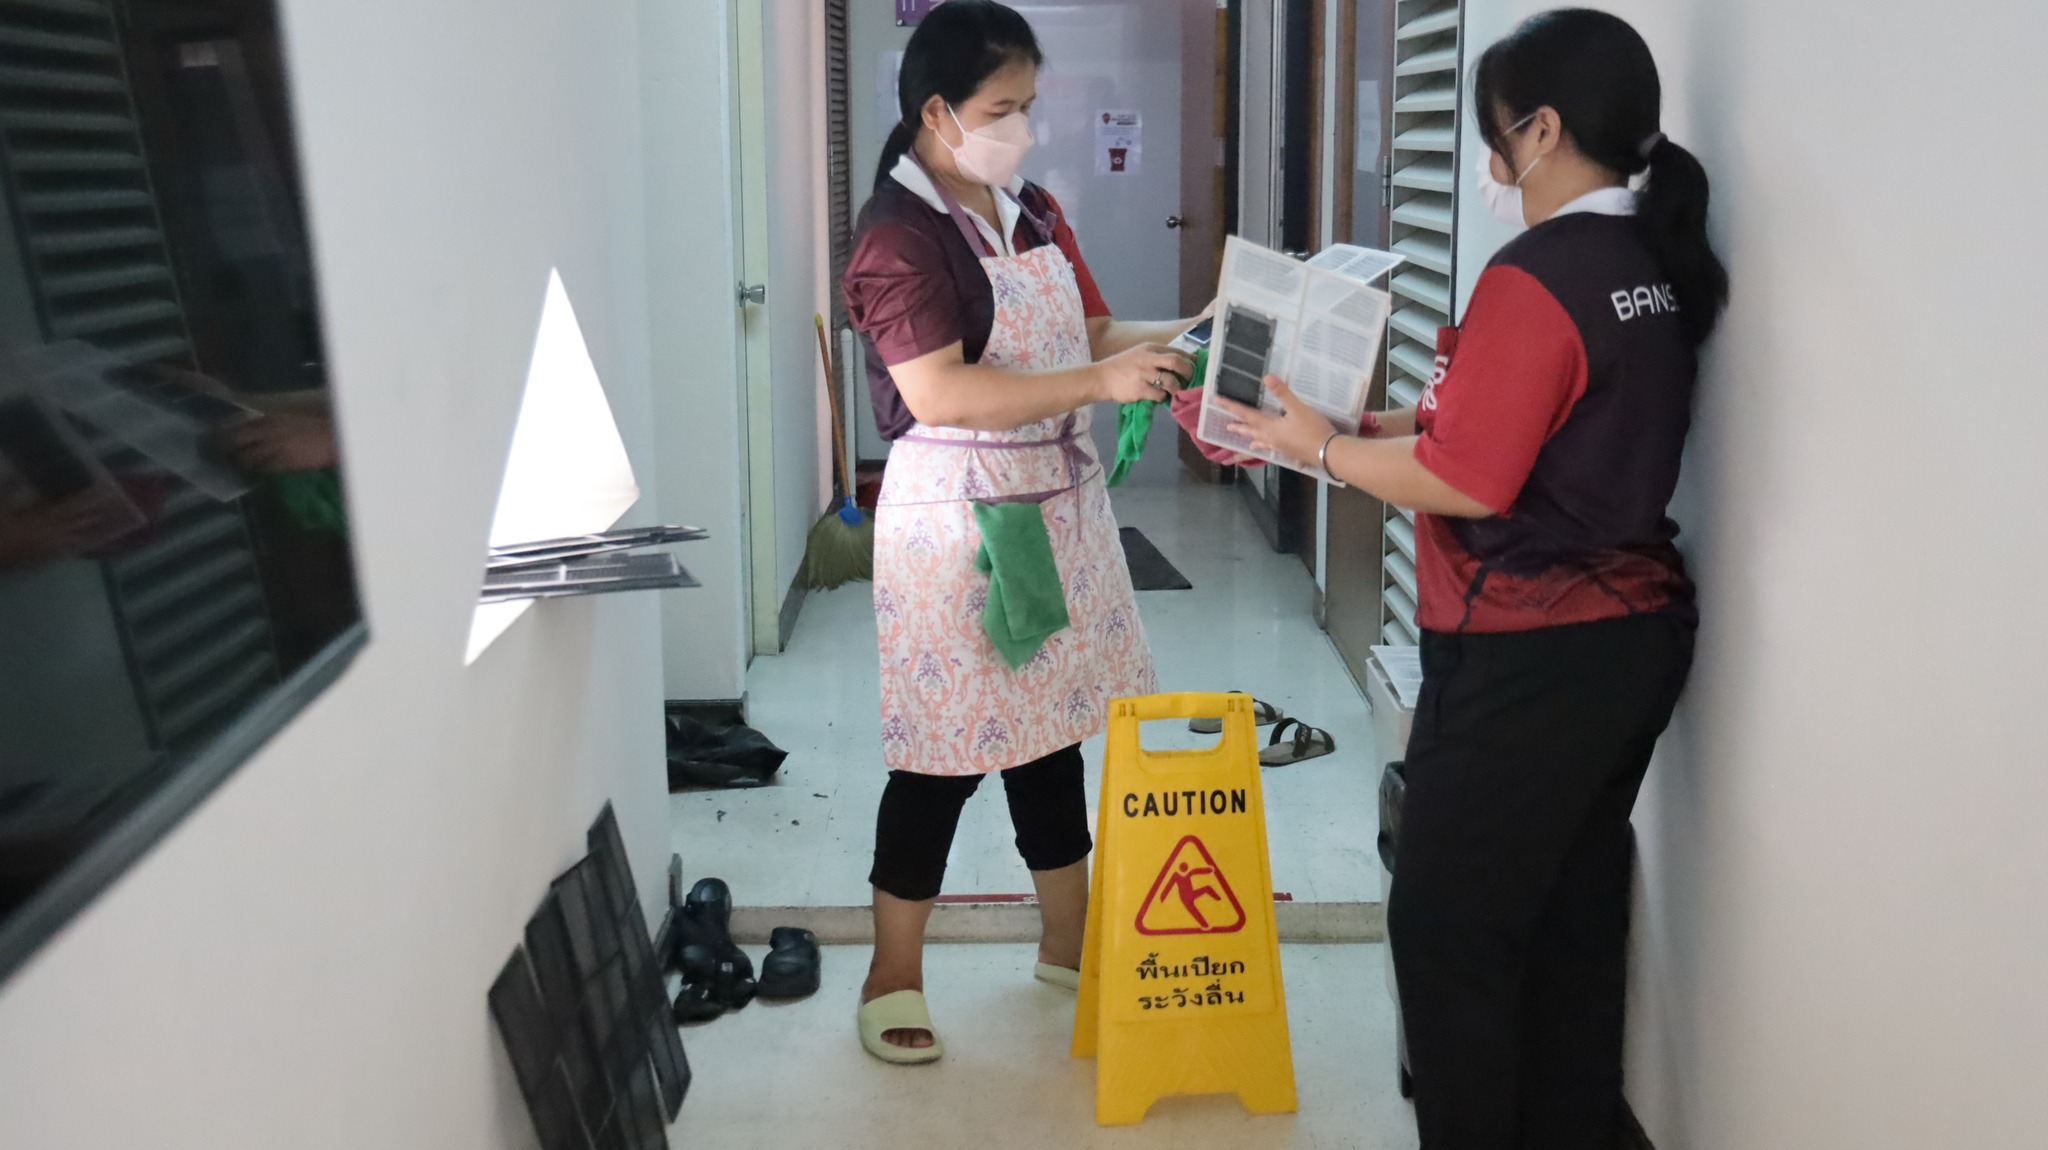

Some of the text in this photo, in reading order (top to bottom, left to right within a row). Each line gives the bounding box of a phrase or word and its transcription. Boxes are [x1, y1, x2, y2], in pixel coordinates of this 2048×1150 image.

[1123, 789, 1246, 818] CAUTION
[1136, 952, 1245, 980] พื้นเปียก
[1138, 979, 1245, 1010] ระวังลื่น
